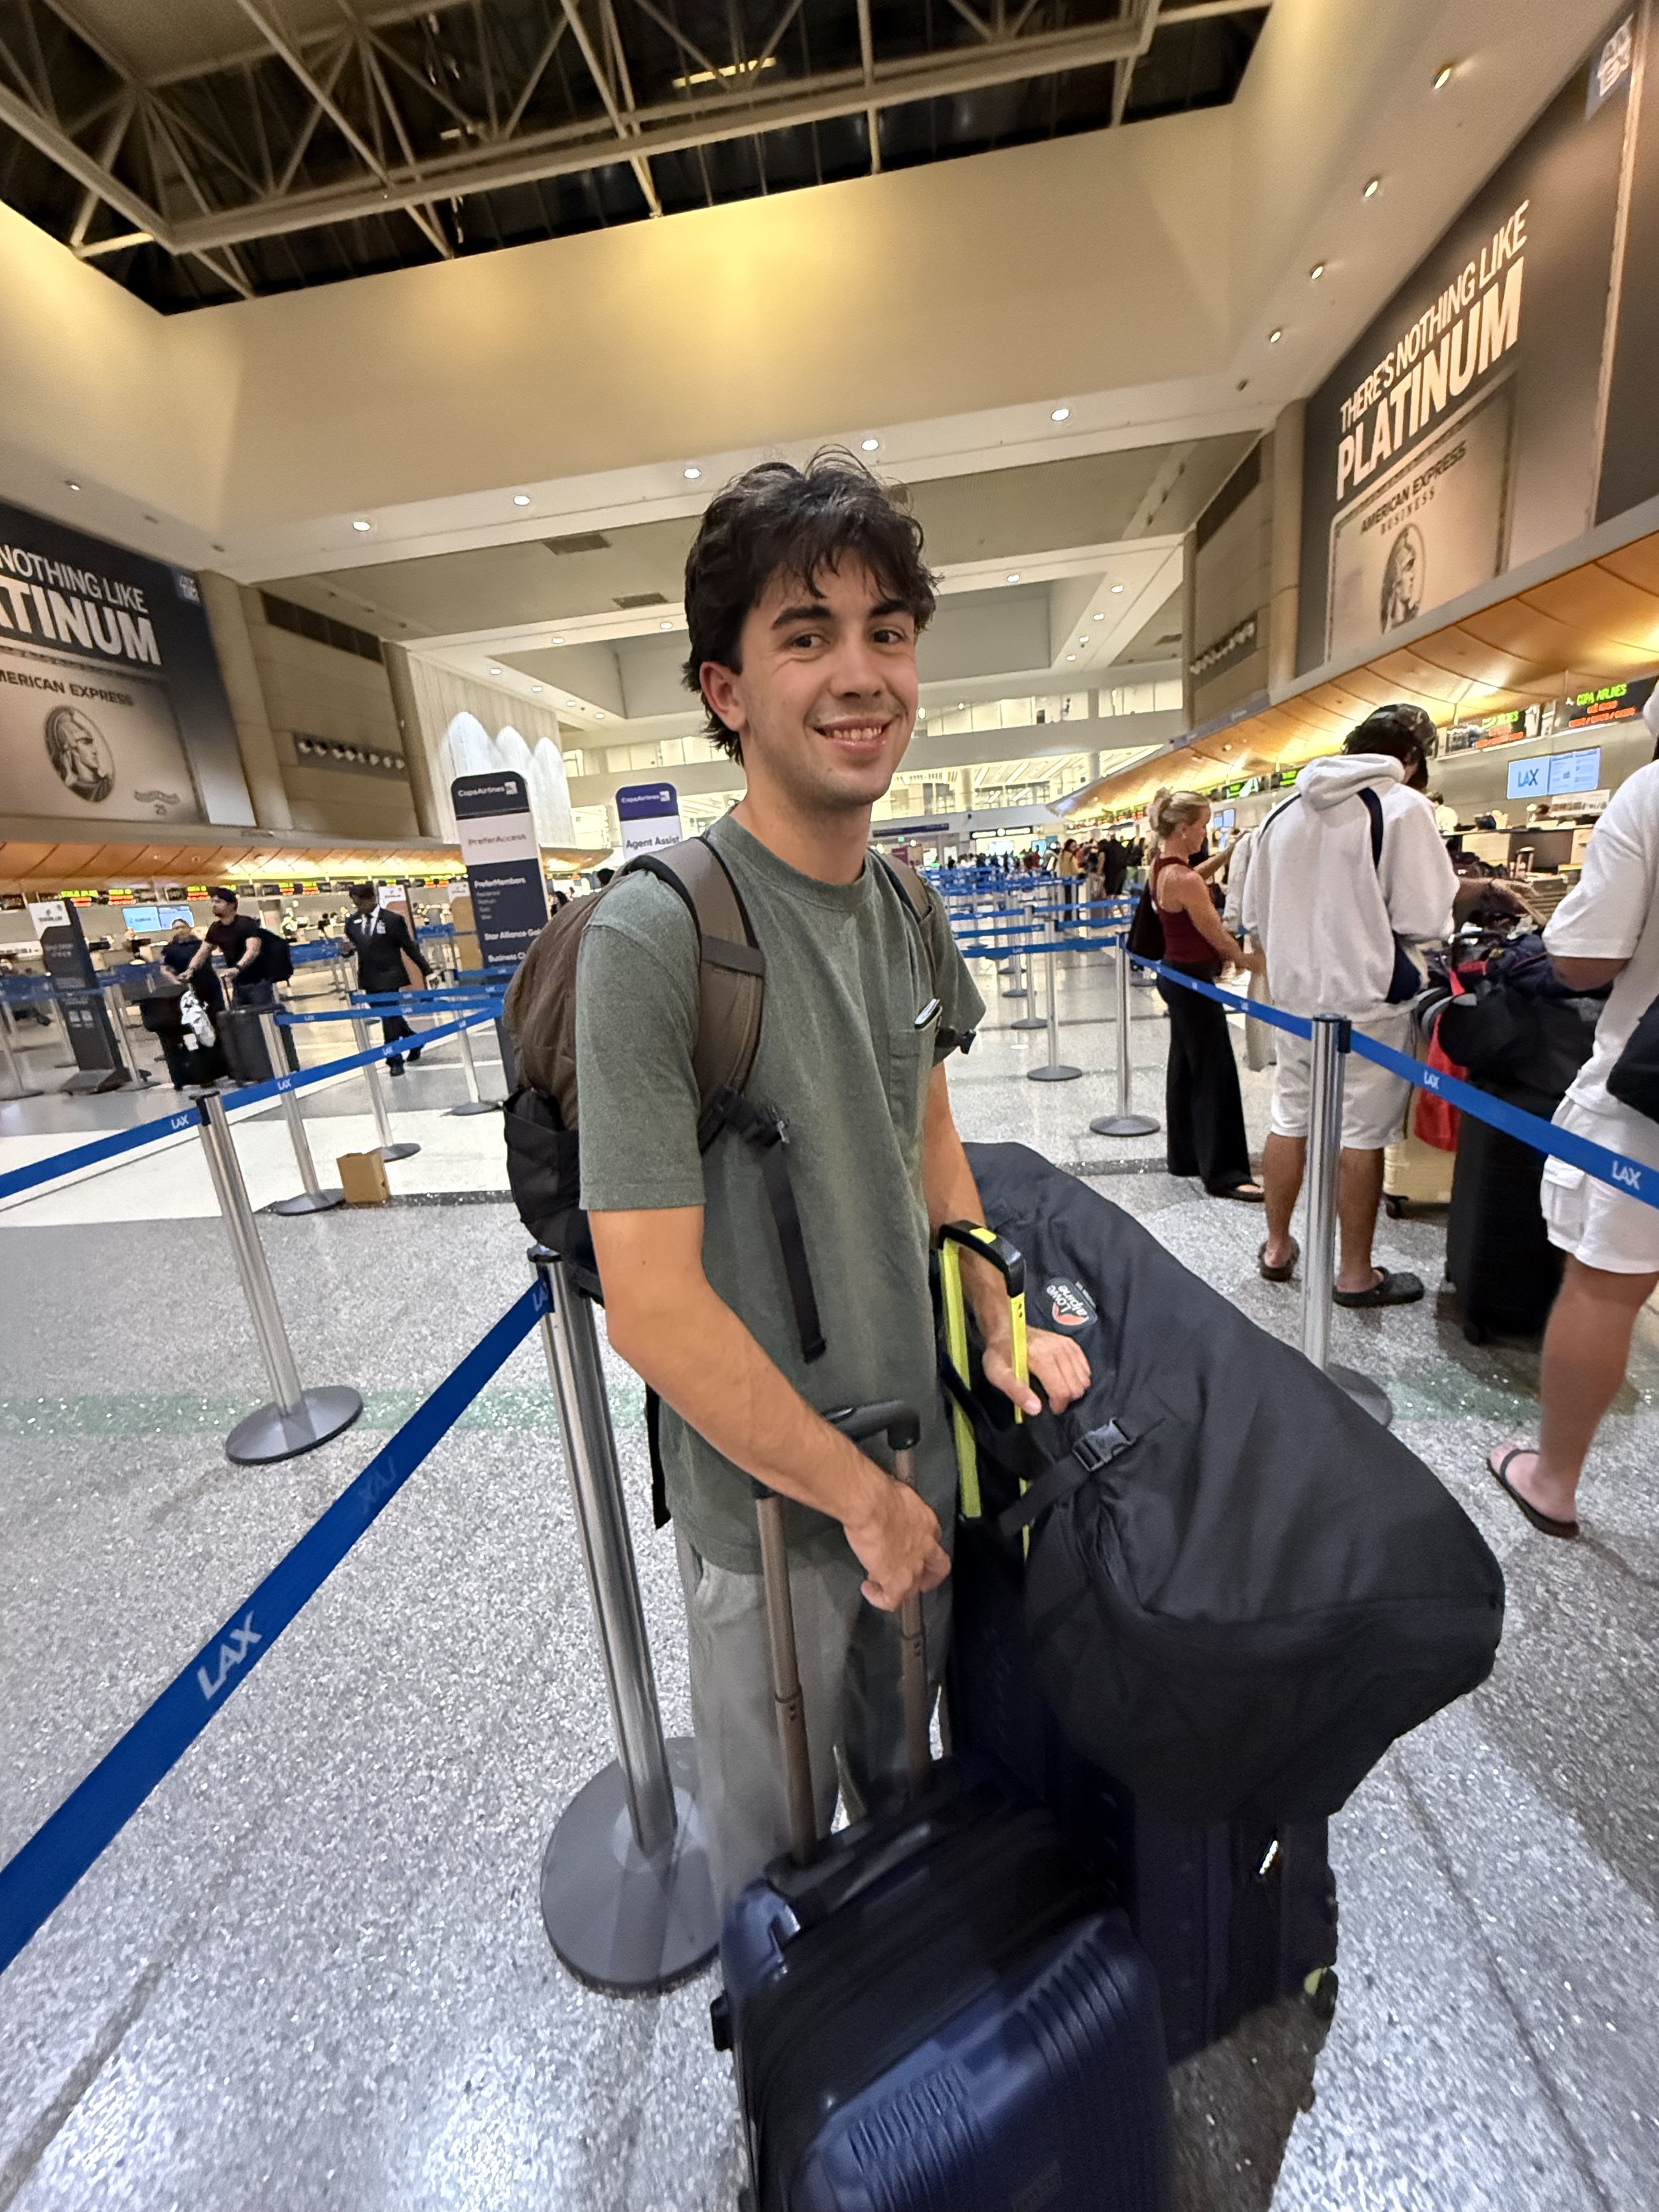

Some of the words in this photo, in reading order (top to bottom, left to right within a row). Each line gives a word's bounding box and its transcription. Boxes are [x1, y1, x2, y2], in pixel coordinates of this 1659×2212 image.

[1339, 350, 1395, 434] THERE'S
[1396, 260, 1477, 376] NOTHING
[1478, 198, 1530, 287] LIKE
[1336, 256, 1525, 501] PLATINUM
[1361, 484, 1411, 535] AMERICAN
[1411, 439, 1467, 496] EXPRESS
[103, 577, 149, 614] LIKE
[0, 575, 162, 666] TINUM
[68, 683, 135, 707] EXPRESS
[1517, 768, 1540, 788] LAX
[626, 839, 653, 849] Agent
[654, 836, 680, 846] Assist
[277, 1078, 292, 1090] LAX
[171, 1114, 190, 1130] LAX
[1611, 1159, 1642, 1191] LAX
[1046, 1284, 1071, 1313] Lowe
[1058, 1284, 1088, 1317] alpine
[196, 1611, 263, 1702] LAX
